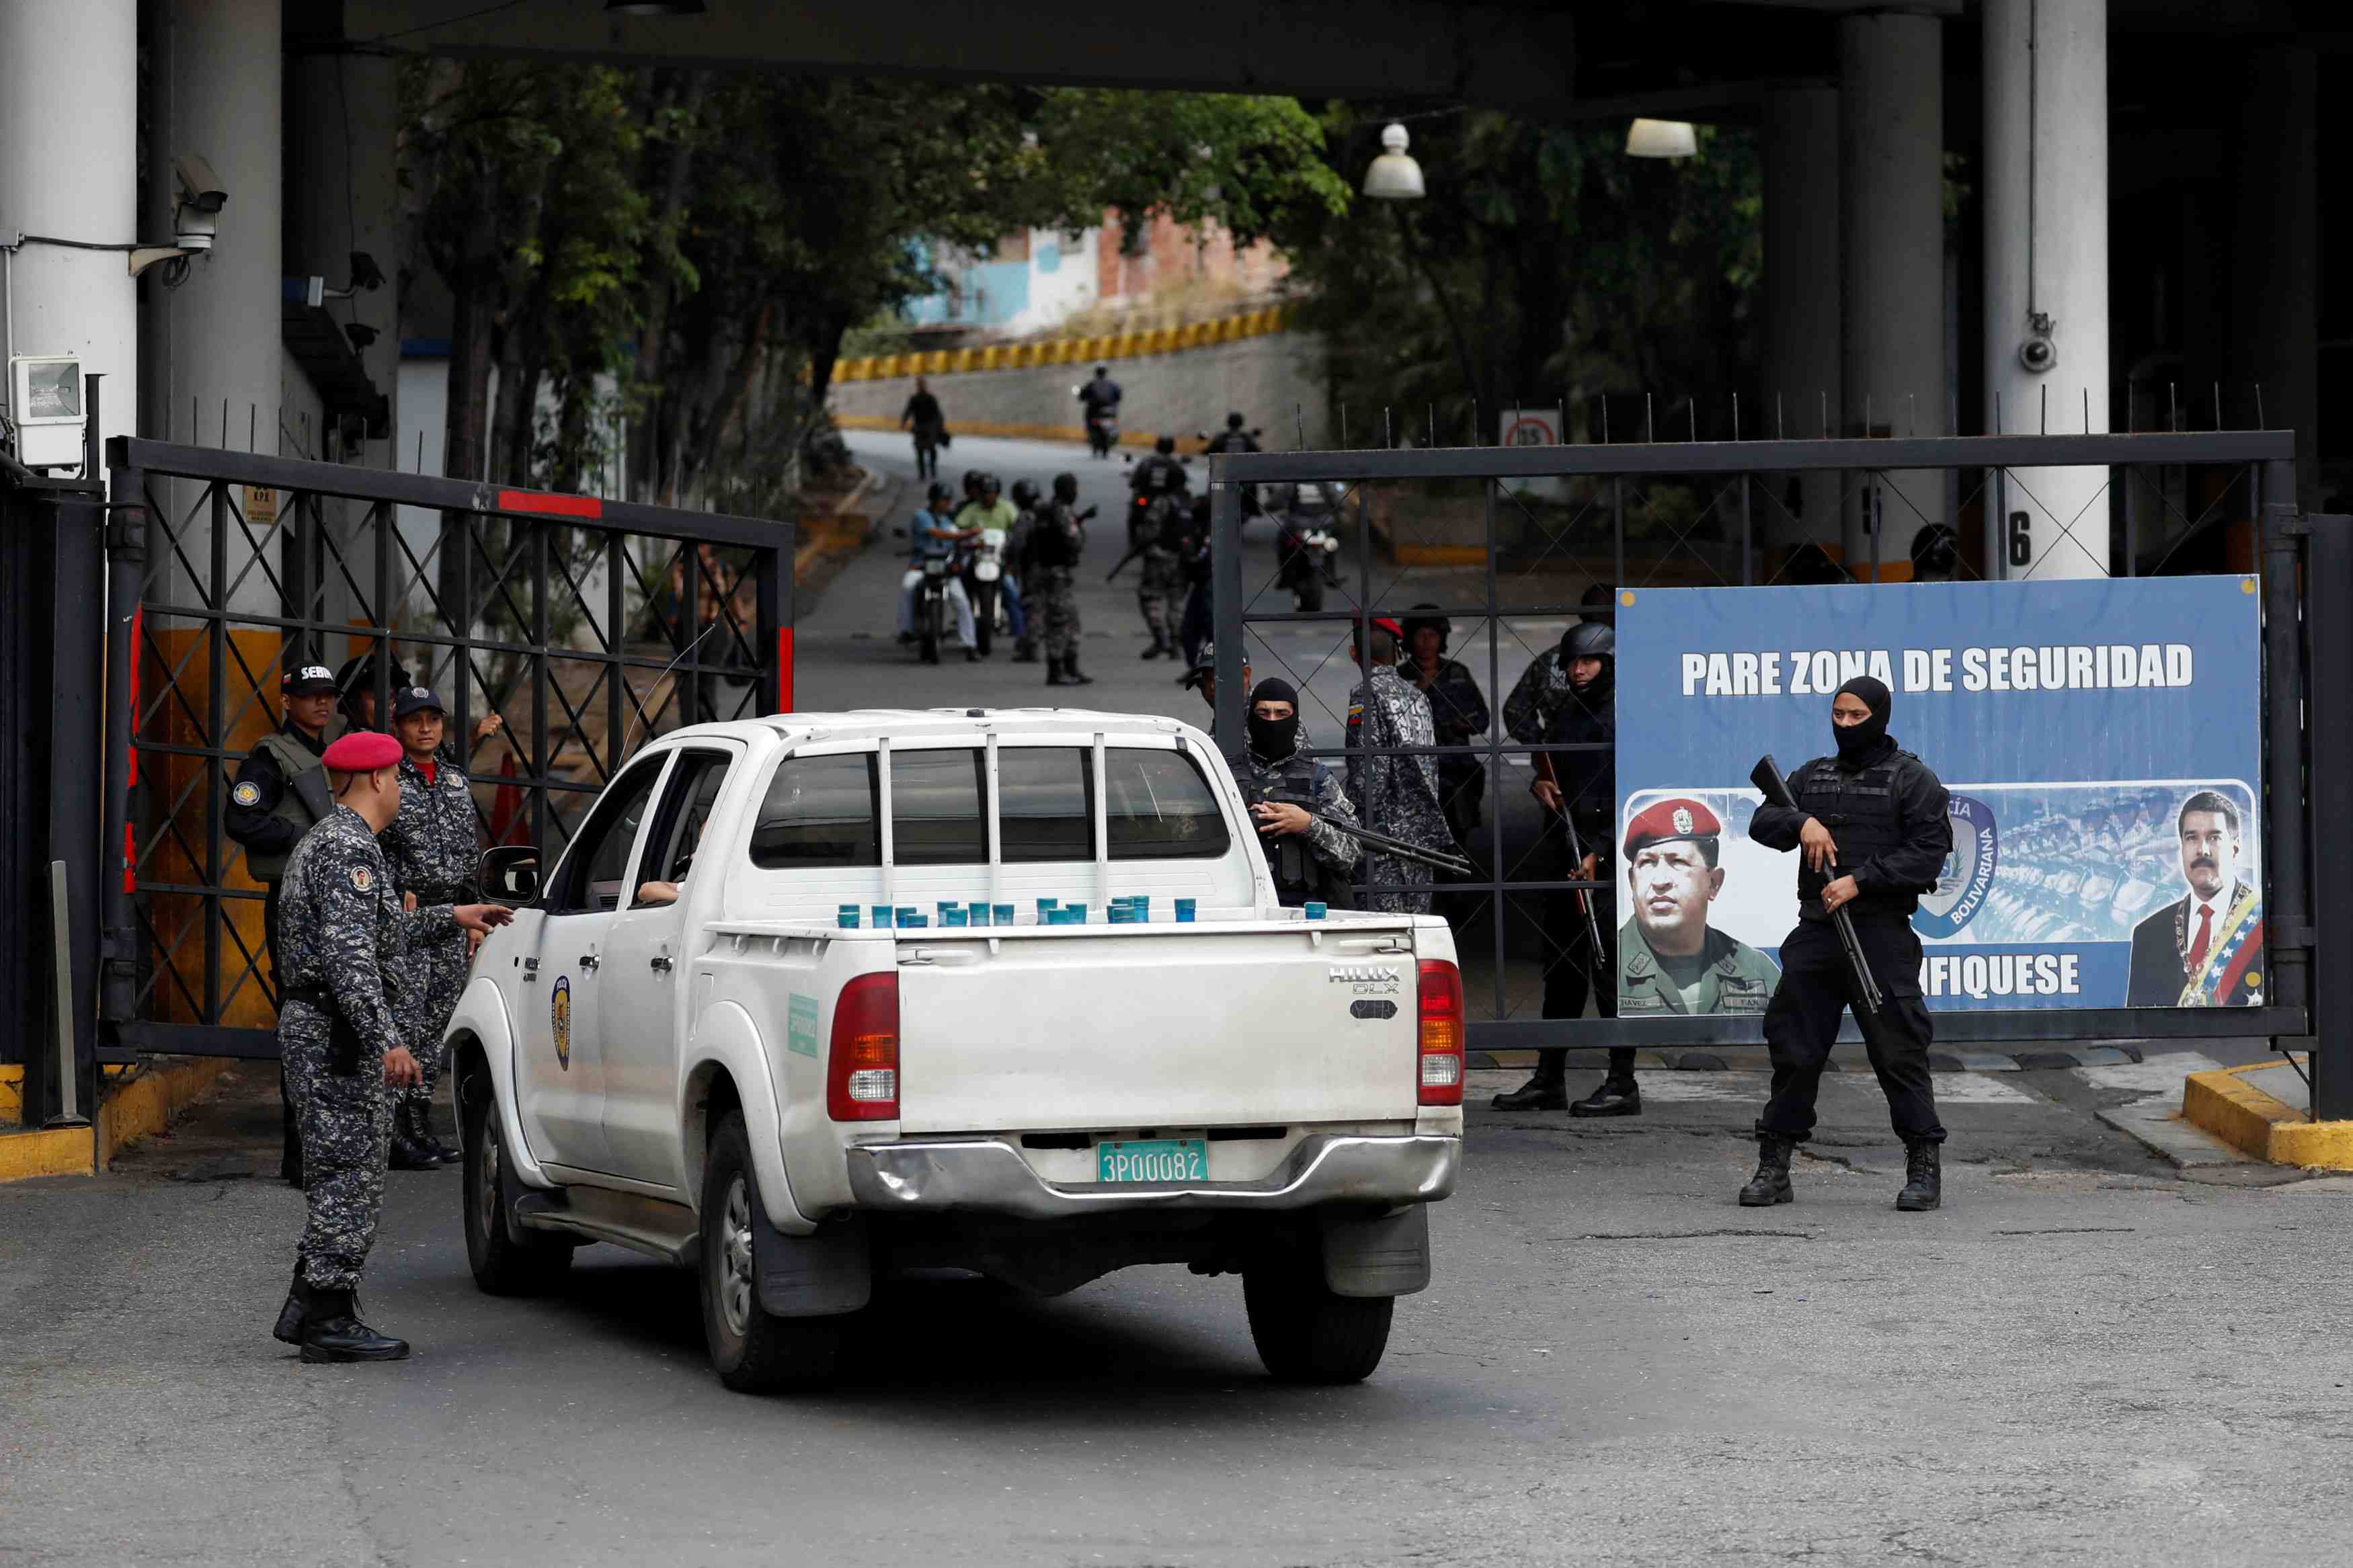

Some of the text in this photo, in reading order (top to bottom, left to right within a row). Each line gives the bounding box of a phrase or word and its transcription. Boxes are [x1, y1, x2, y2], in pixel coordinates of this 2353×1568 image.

[2009, 511, 2030, 566] 6
[1681, 644, 2193, 696] PARE ZONA DE SEGURIDAD
[1950, 827, 1994, 925] BOLIVARIANA
[1329, 966, 1400, 983] HILUX
